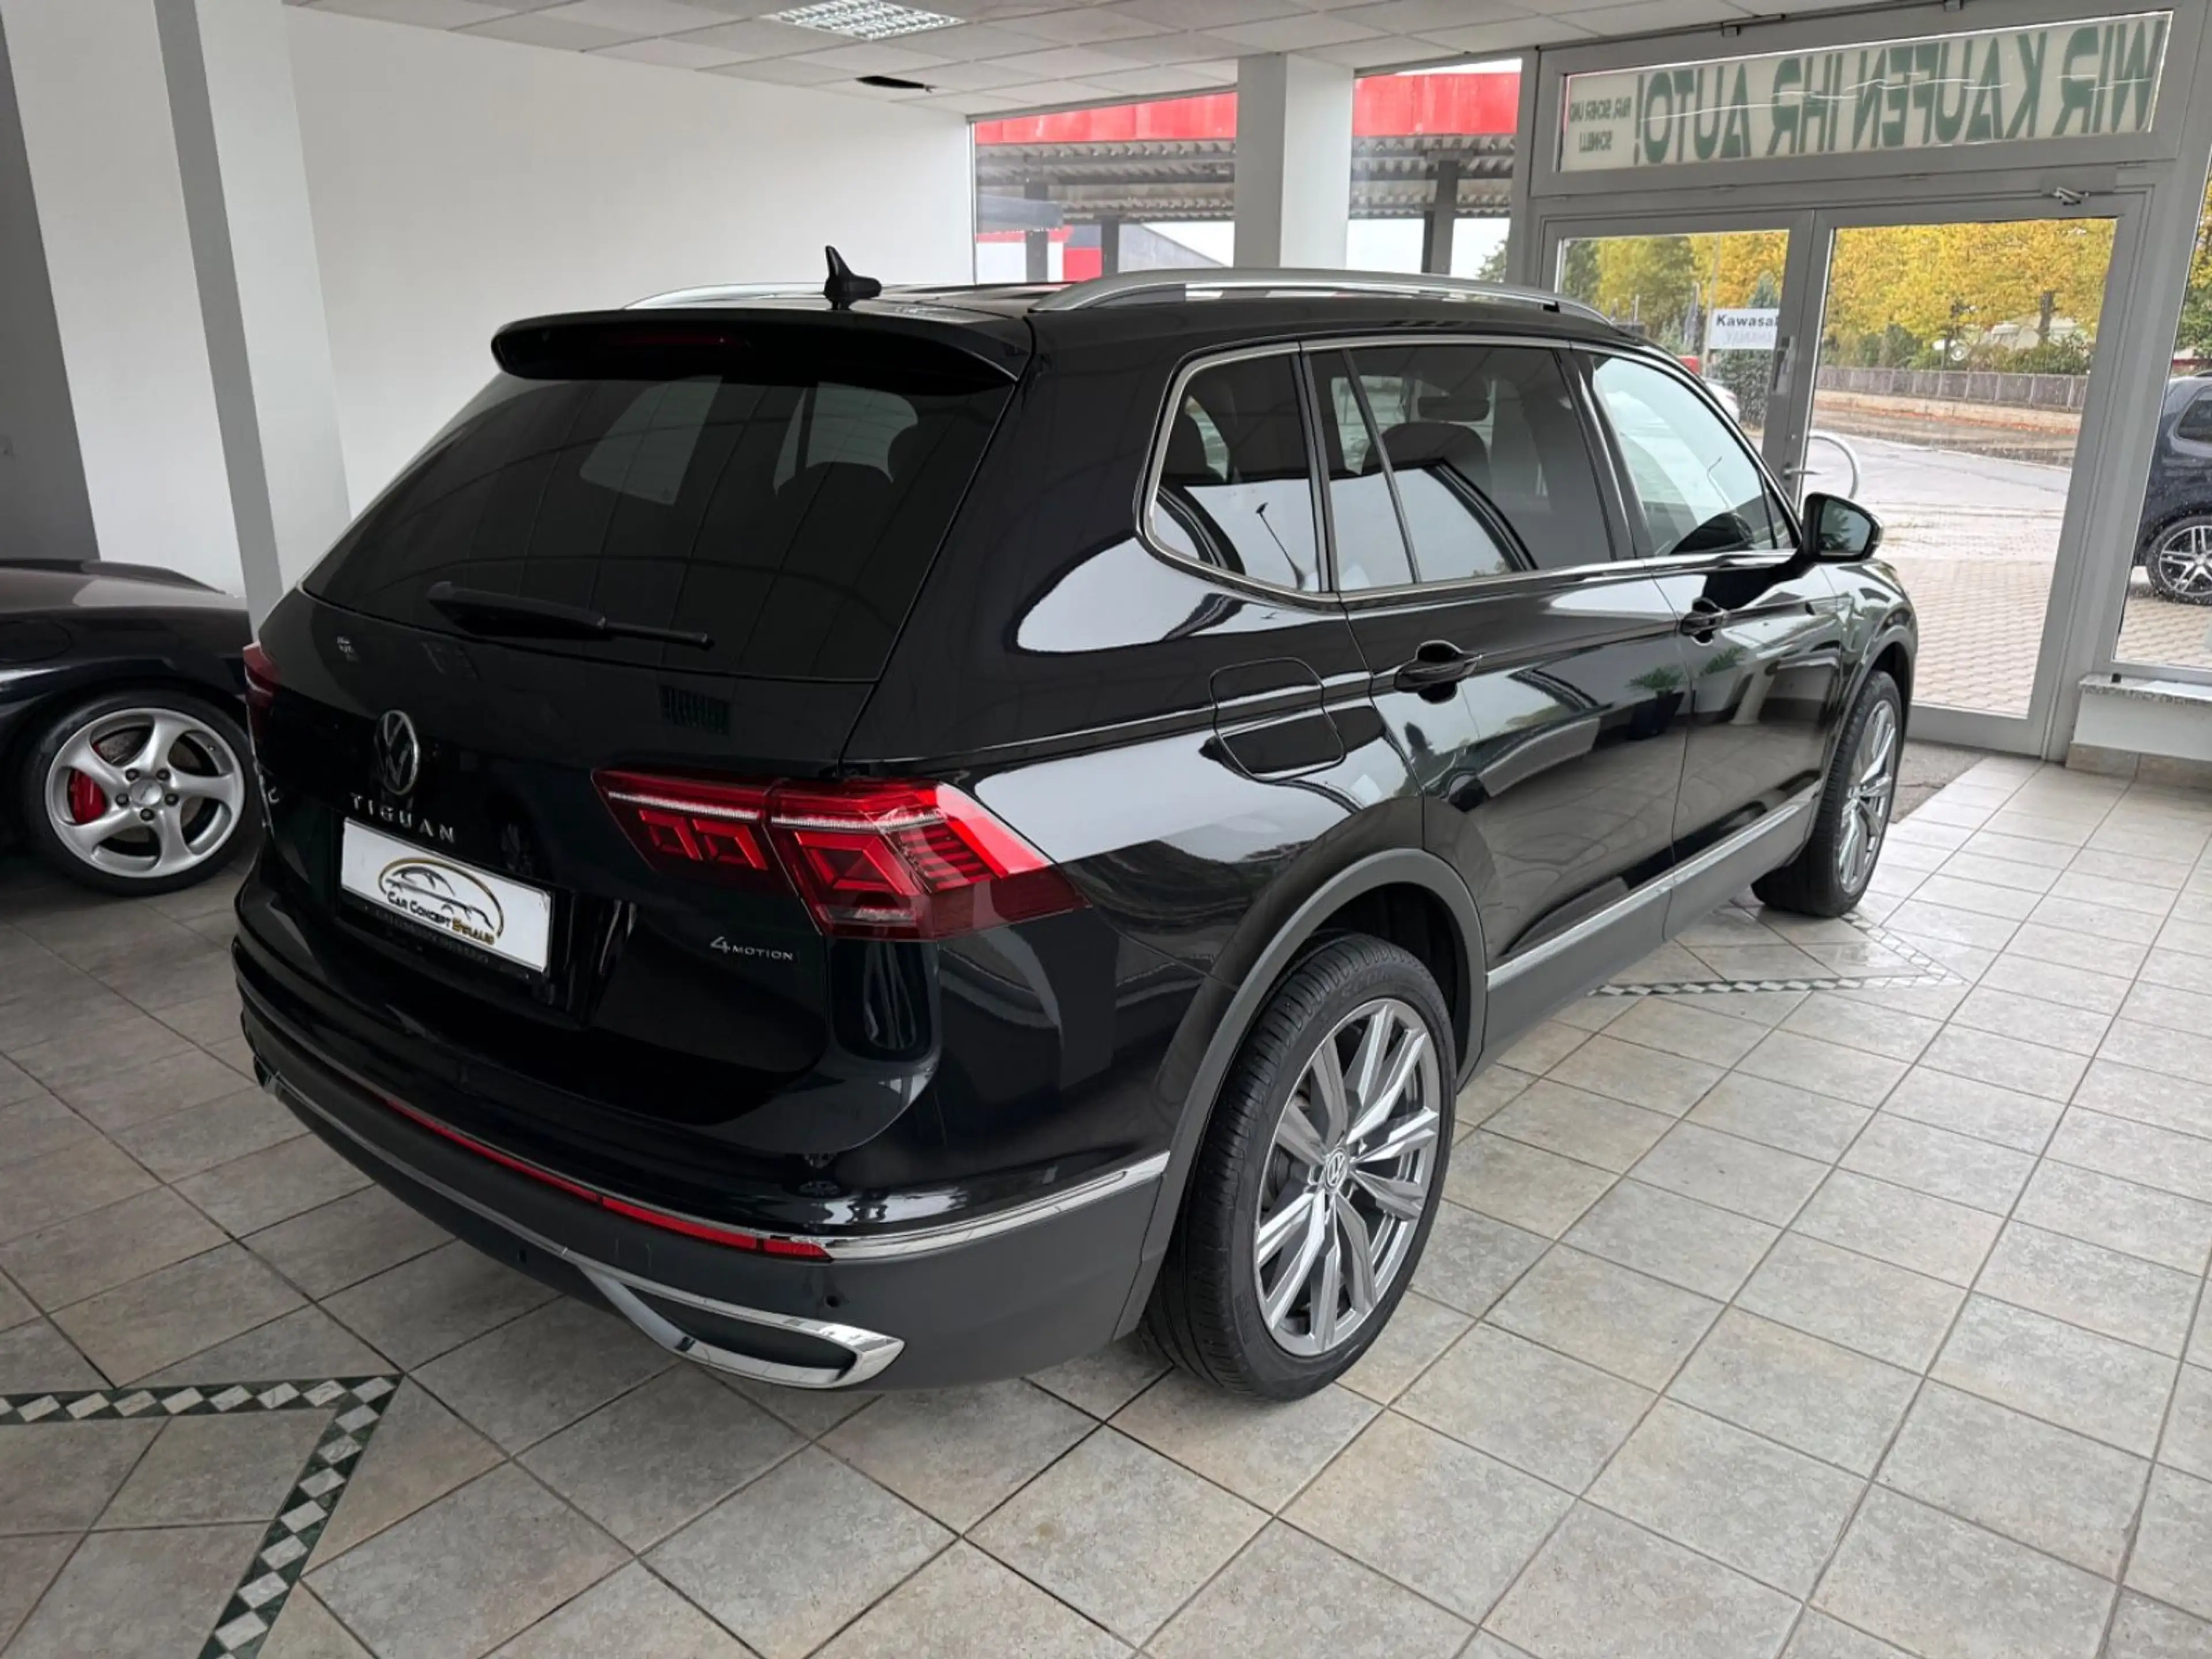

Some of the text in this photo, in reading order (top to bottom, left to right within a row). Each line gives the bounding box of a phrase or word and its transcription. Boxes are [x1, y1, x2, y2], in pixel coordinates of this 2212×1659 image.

[1716, 314, 1779, 327] Kawasa
[350, 792, 454, 843] TIGUAN
[710, 936, 793, 961] 4MOTION
